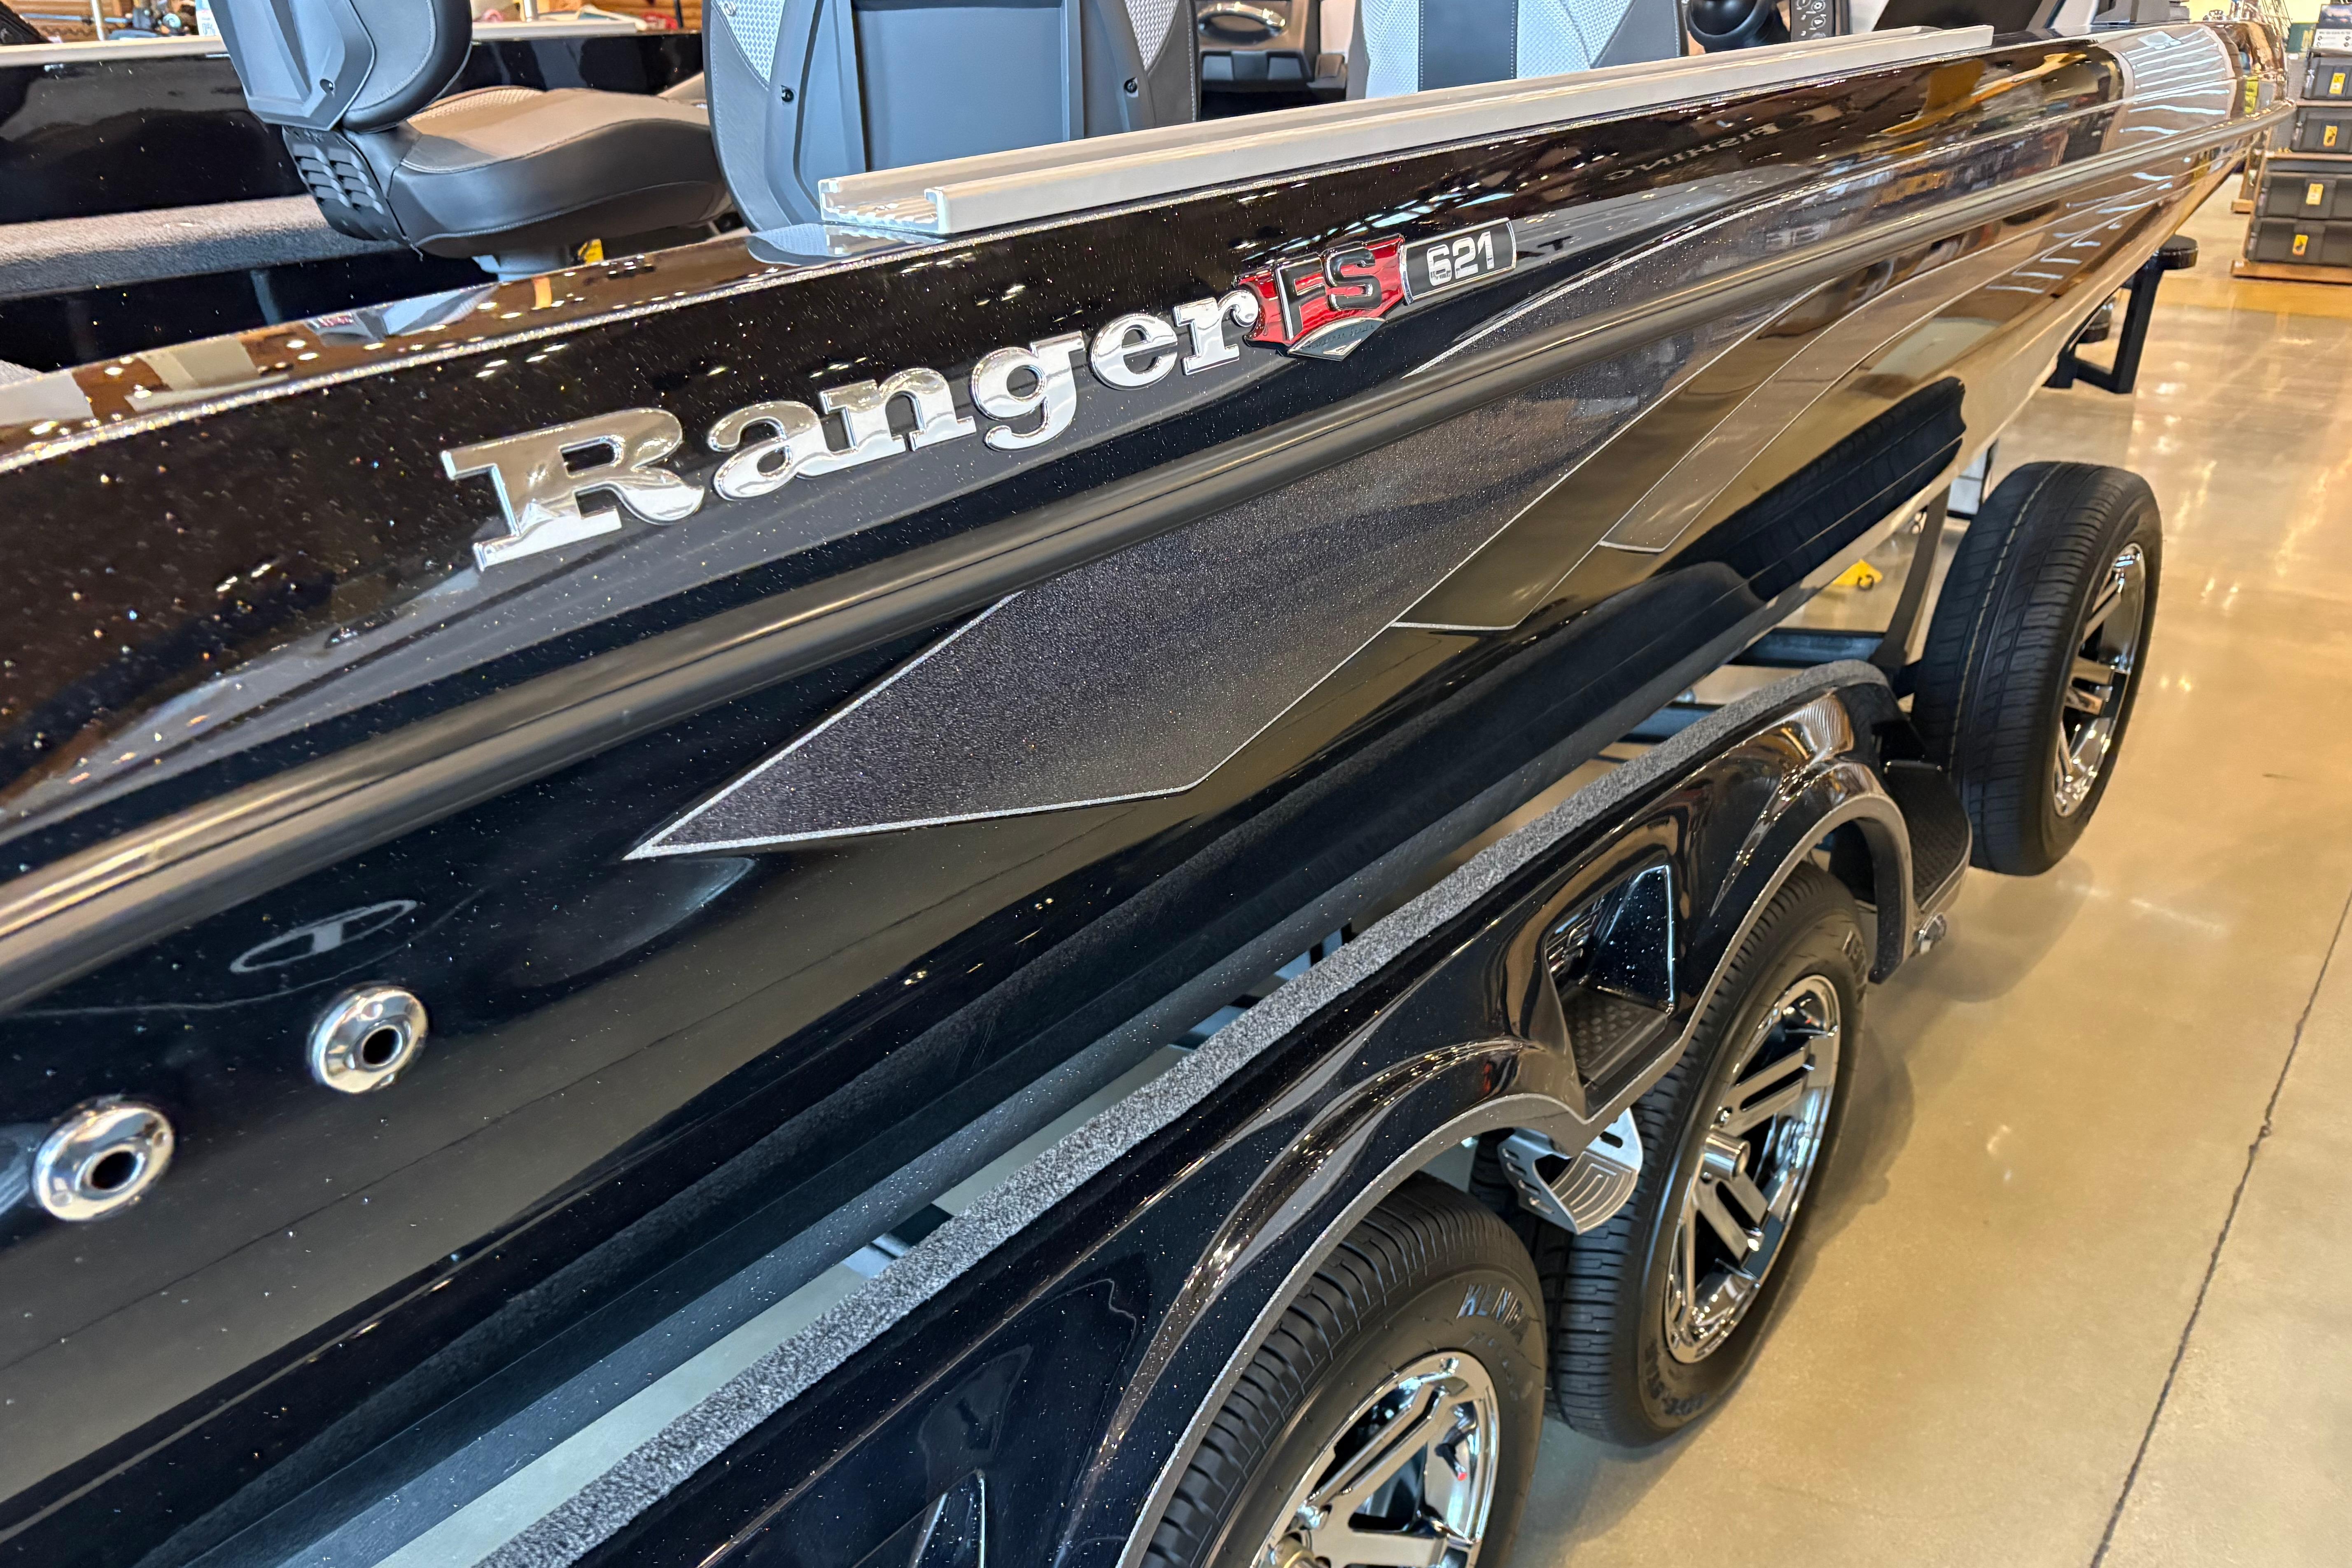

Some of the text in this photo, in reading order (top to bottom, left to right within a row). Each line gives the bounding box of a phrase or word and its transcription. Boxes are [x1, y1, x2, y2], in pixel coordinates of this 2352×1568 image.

[441, 231, 1495, 572] Ranger FS 621
